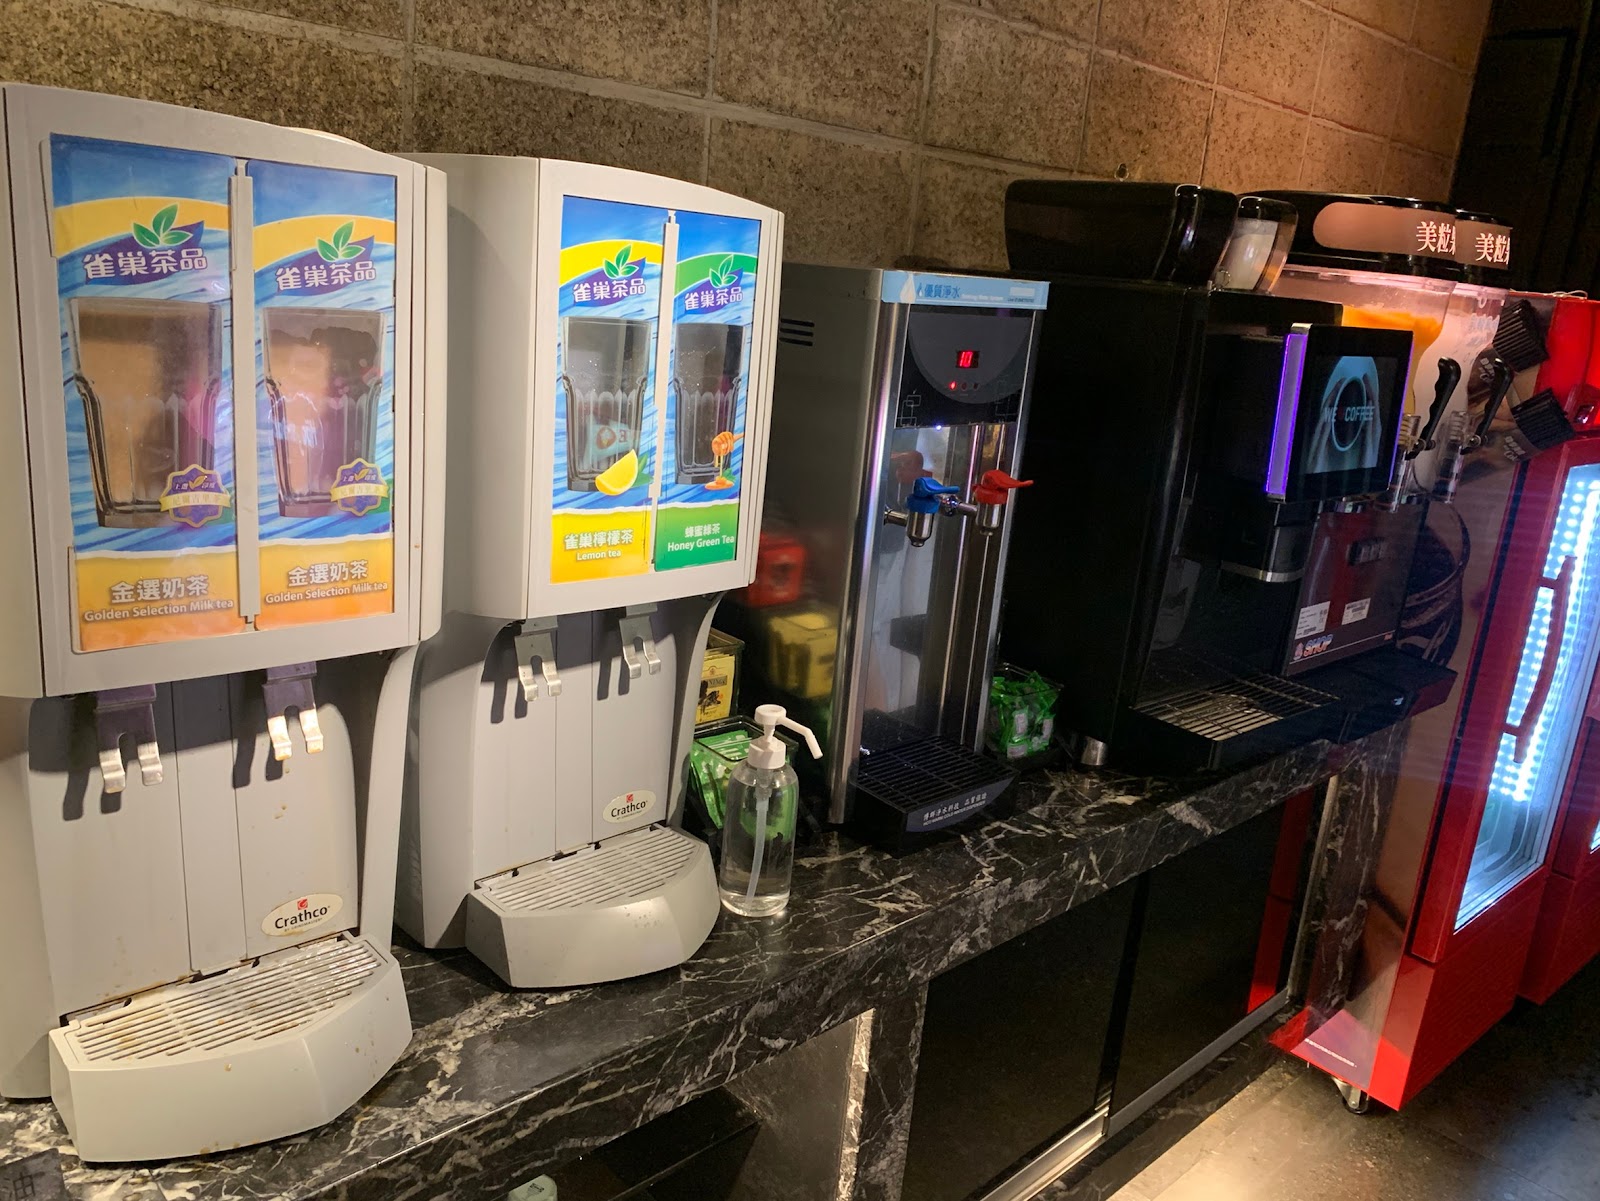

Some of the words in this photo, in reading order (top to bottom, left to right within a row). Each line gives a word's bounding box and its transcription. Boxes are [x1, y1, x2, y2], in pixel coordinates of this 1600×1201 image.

[82, 248, 208, 281] 雀巢茶品
[275, 261, 377, 291] 雀巢茶品
[573, 278, 646, 303] 雀巢茶品
[684, 286, 744, 311] 雀巢茶品
[1344, 406, 1375, 422] COFFEE
[564, 528, 634, 550] 雀巢檸檬茶
[667, 539, 695, 553] Honey
[696, 537, 721, 548] Green
[721, 535, 735, 545] Tea
[577, 551, 607, 561] Lemon
[608, 549, 621, 558] tea
[288, 560, 369, 587] 金選奶茶
[110, 575, 209, 604] 金選奶茶
[265, 588, 303, 604] Golden
[305, 585, 351, 600] Selection
[352, 582, 372, 595] Milk
[373, 581, 388, 592] tea
[84, 606, 130, 622] Golden
[133, 603, 188, 618] Selection
[190, 599, 214, 612] Milk
[215, 598, 234, 610] tea
[611, 800, 646, 818] Crathco
[274, 907, 328, 929] Crathco
